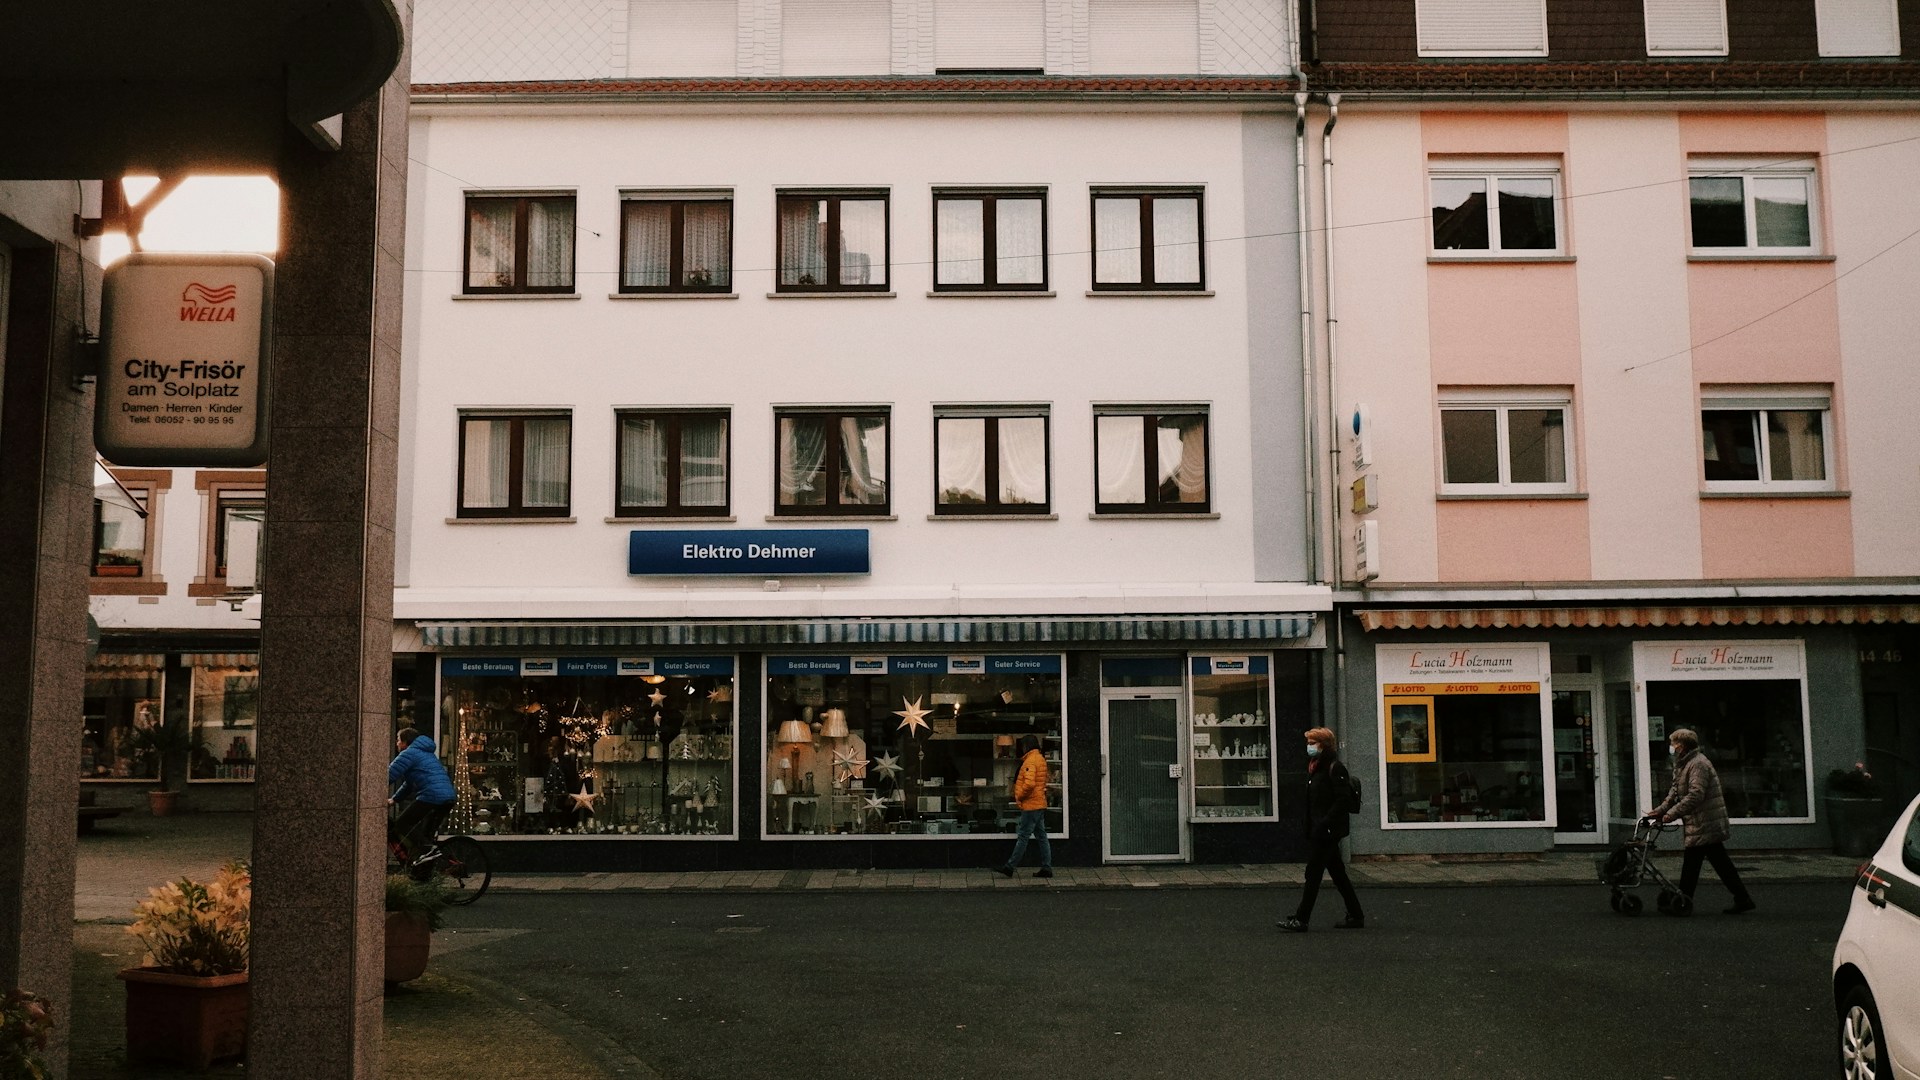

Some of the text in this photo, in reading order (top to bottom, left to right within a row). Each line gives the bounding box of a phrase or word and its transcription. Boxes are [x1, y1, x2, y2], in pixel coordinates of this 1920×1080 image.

[180, 307, 236, 322] WELLA
[124, 359, 246, 382] City-Frisör
[127, 382, 240, 399] am Solplatz
[122, 403, 243, 413] Damen Herren Kinder
[154, 416, 185, 424] 06052
[193, 416, 206, 424] 90
[208, 416, 220, 424] 95
[222, 416, 234, 424] 95
[683, 543, 817, 559] Elektro Dehmer
[1410, 649, 1512, 668] Lucia Holzmann
[1672, 647, 1774, 665] Lucia Holzmann
[462, 663, 514, 672] Beste Beratung
[567, 662, 608, 670] Faire Preise
[664, 662, 711, 670] Guter Service
[788, 661, 841, 670] Beste Beratung
[897, 661, 938, 669] Faire Preise
[994, 660, 1041, 668] Guter Service
[1508, 684, 1532, 692] LOTTO
